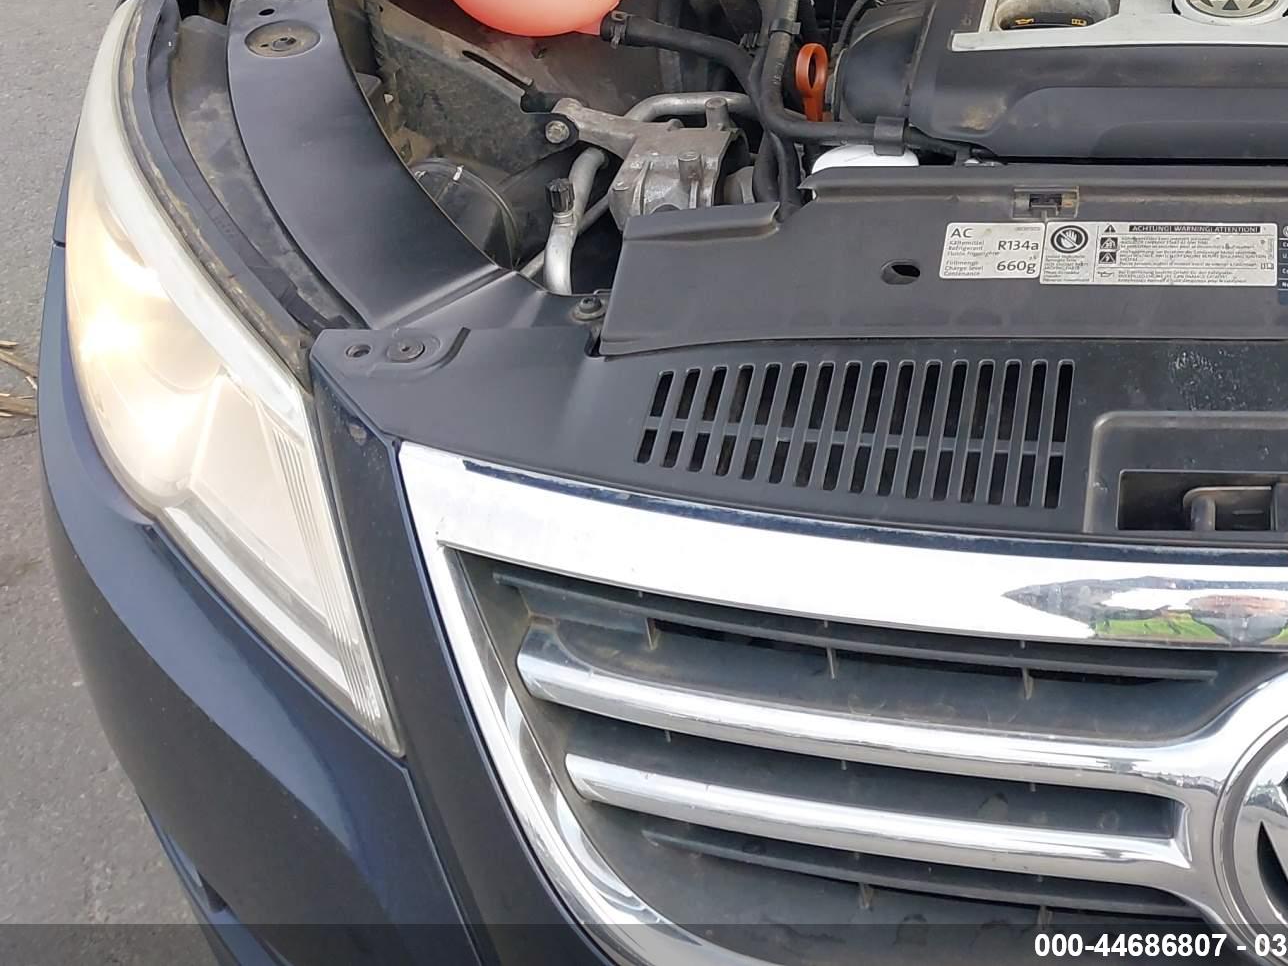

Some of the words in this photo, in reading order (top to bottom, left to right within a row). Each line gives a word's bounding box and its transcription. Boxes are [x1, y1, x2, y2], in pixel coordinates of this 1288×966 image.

[950, 227, 974, 239] AC
[997, 240, 1039, 251] R134a
[996, 260, 1037, 276] 660g
